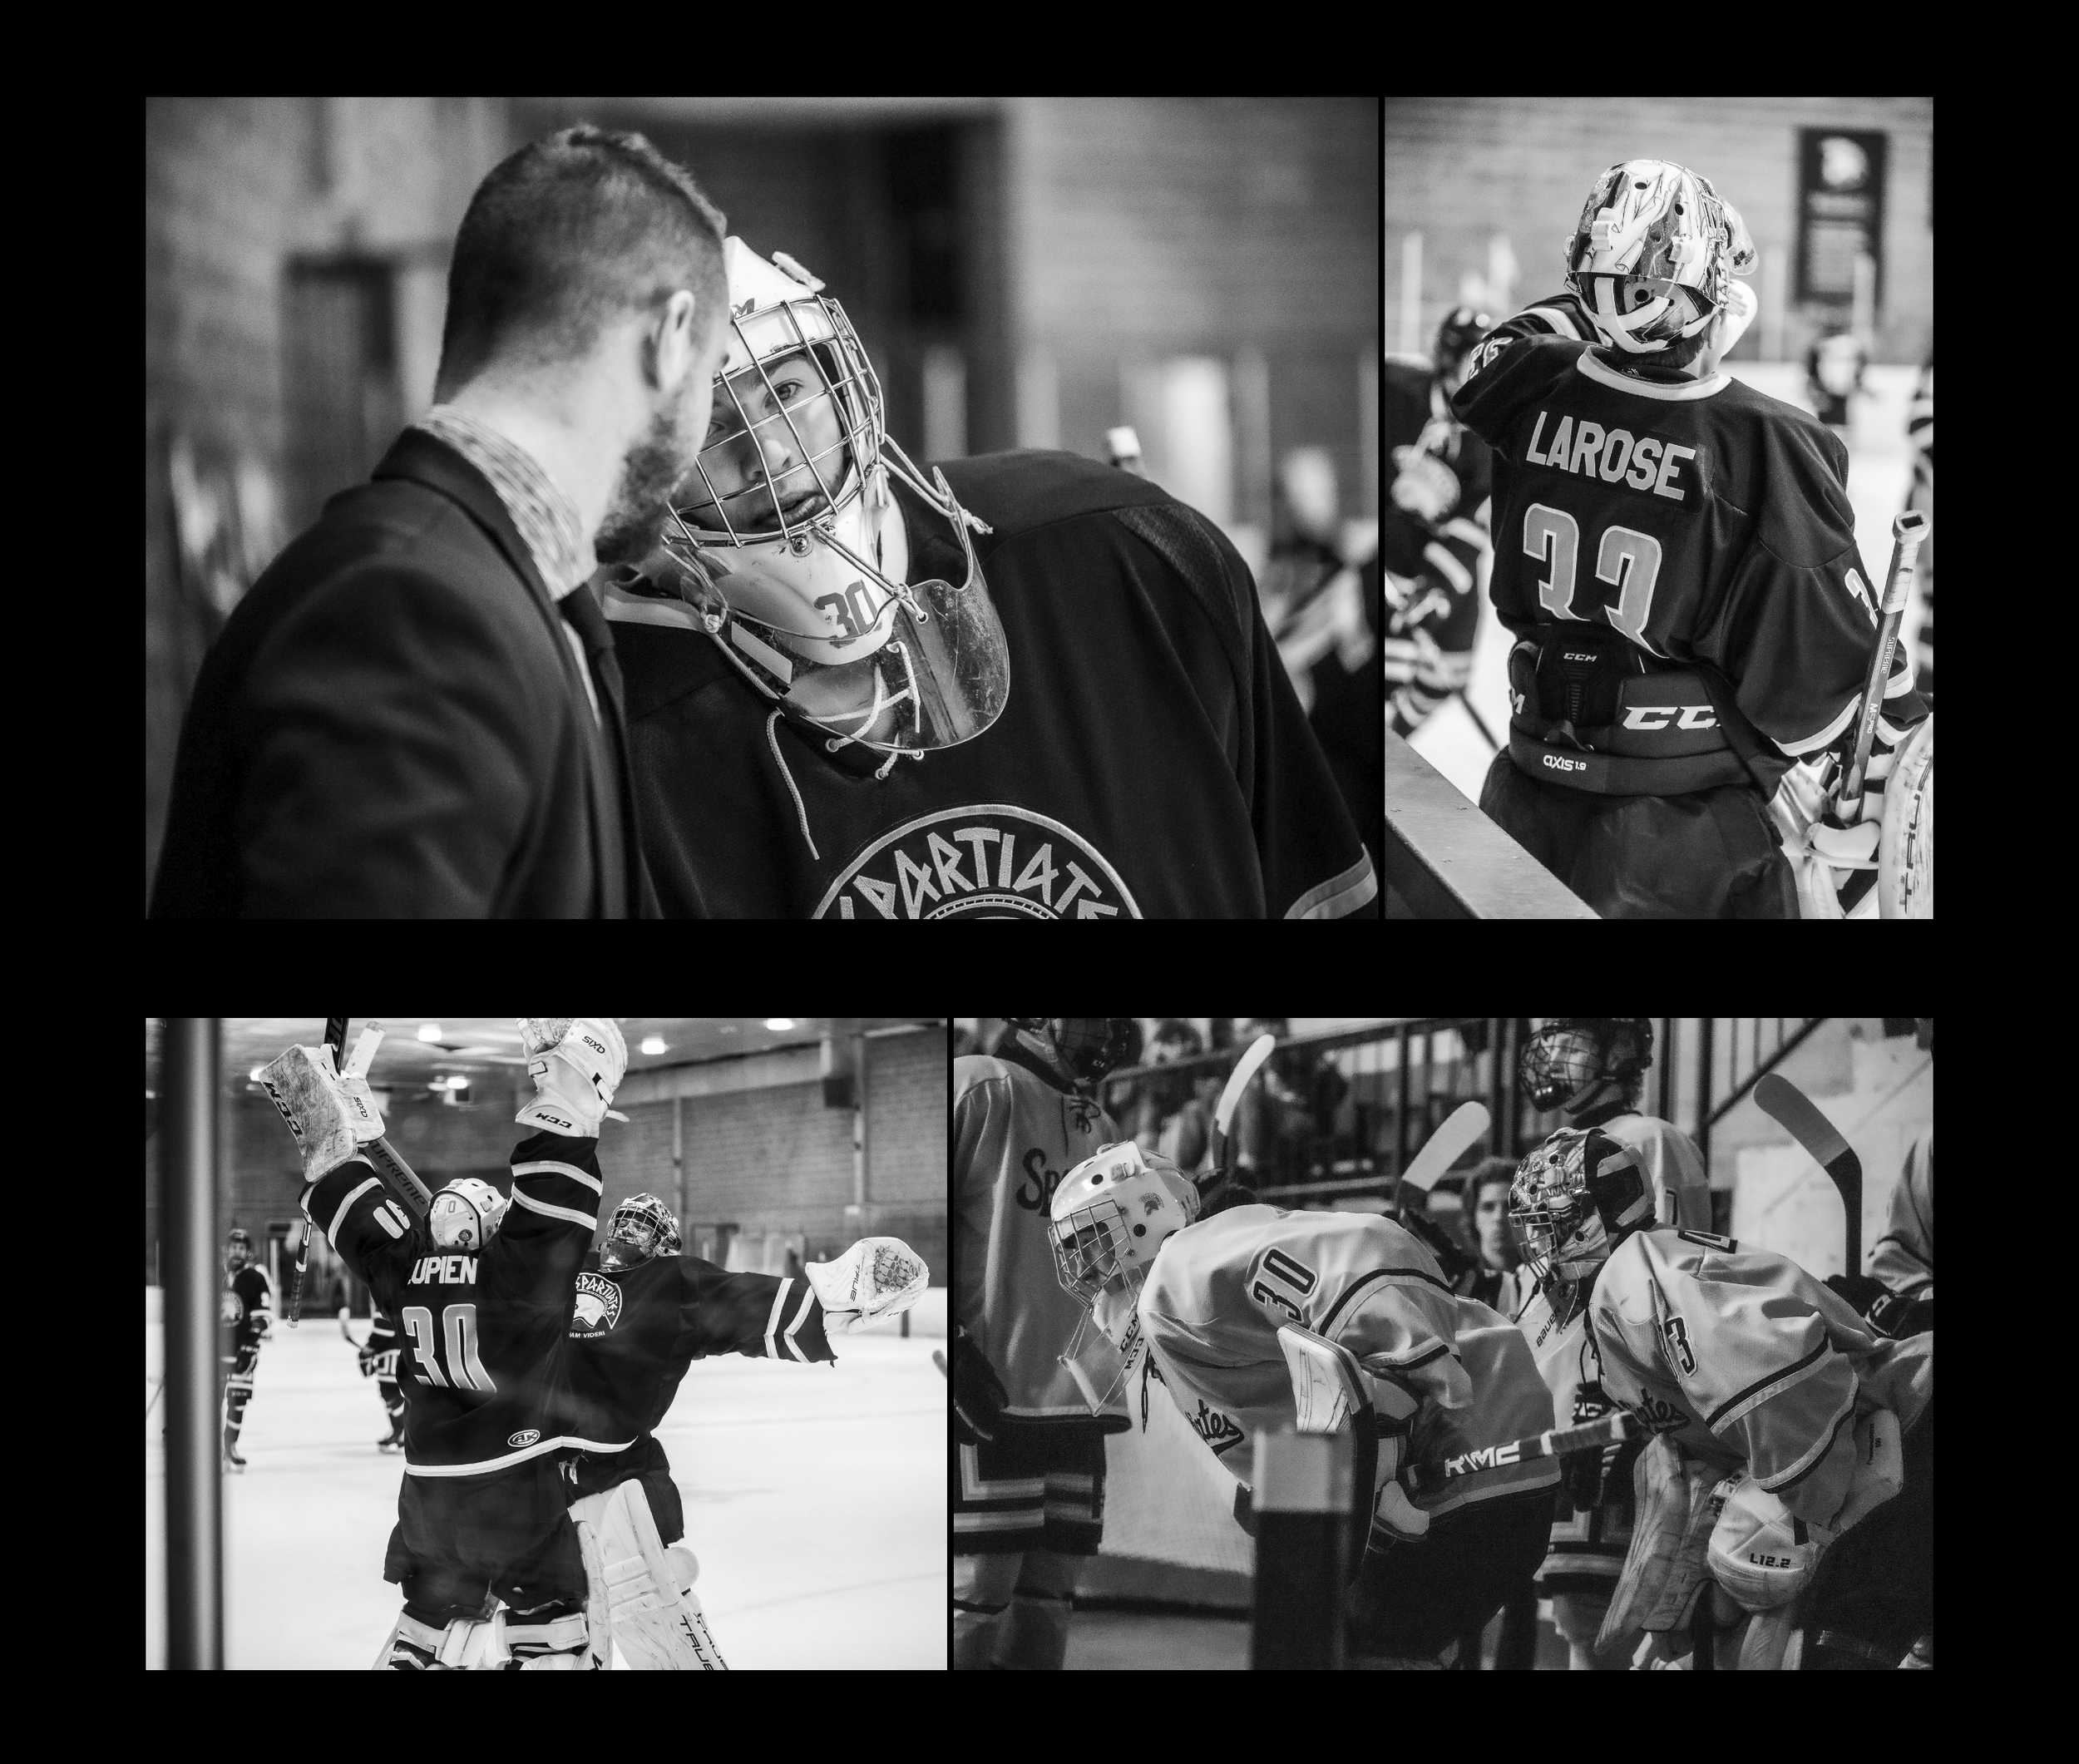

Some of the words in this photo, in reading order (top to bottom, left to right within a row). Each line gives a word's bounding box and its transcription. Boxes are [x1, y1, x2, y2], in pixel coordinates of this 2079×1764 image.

[1525, 410, 1696, 502] LAROSE
[813, 579, 883, 650] 30
[1563, 652, 1598, 662] CCM
[1622, 705, 1721, 730] CC
[263, 1081, 303, 1135] CCM
[535, 1112, 573, 1129] CCM
[369, 1139, 427, 1207] UPREME
[407, 1255, 479, 1286] UPIEN
[849, 1263, 862, 1302] TRUE
[1251, 1247, 1317, 1323] 30
[402, 1302, 498, 1394] 30
[583, 1331, 605, 1339] VIDERI
[1119, 1312, 1139, 1353] CCM
[1123, 1337, 1145, 1370] CCM
[1750, 1553, 1791, 1569] L12.2
